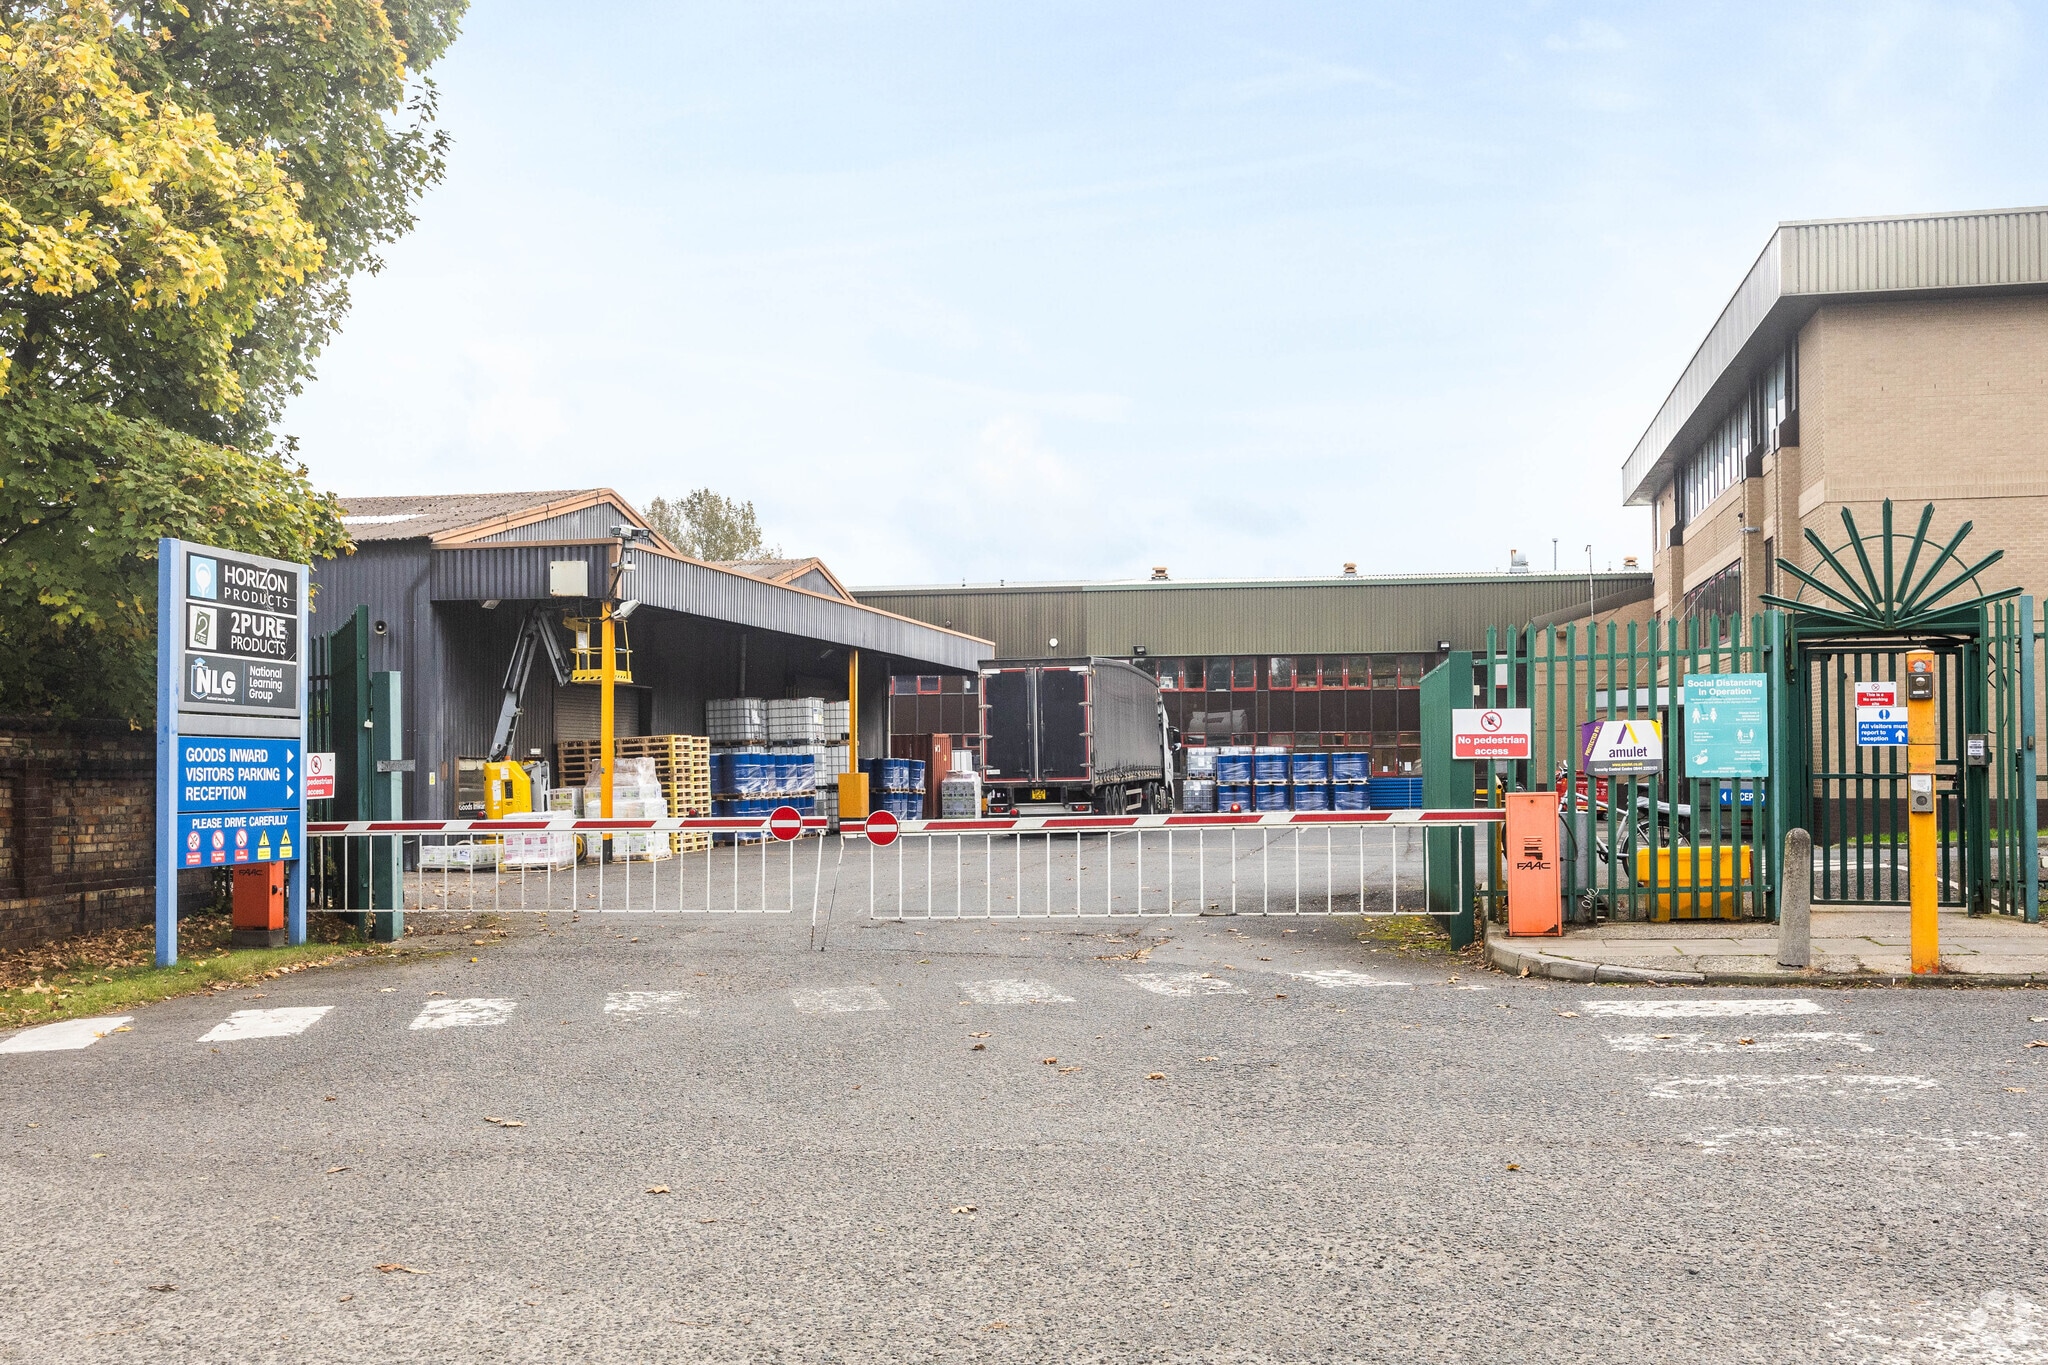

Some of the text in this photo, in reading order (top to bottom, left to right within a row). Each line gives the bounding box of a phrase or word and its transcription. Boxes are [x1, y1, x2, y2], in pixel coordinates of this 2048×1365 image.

[224, 564, 288, 594] HORIZON
[224, 586, 289, 609] PRODUCTS
[197, 616, 208, 638] 2
[230, 611, 287, 640] 2PURE
[230, 635, 287, 656] PRODUCTS
[249, 665, 283, 679] National
[196, 667, 237, 696] NLG
[249, 677, 283, 693] Learning
[1688, 678, 1762, 688] Social Distancing
[248, 688, 274, 704] Group
[1709, 688, 1752, 696] Operation
[1474, 736, 1526, 745] pedestrian
[185, 747, 268, 763] GOODS INWARD
[1609, 746, 1648, 758] amulet
[185, 767, 281, 782] VISITORS PARKING
[307, 778, 332, 786] pedestrian
[185, 786, 247, 801] RECEPTION
[192, 815, 288, 829] PLEASE DRIVE CAREFULLY
[238, 868, 263, 876] FAAC
[1517, 862, 1551, 870] FAAC
